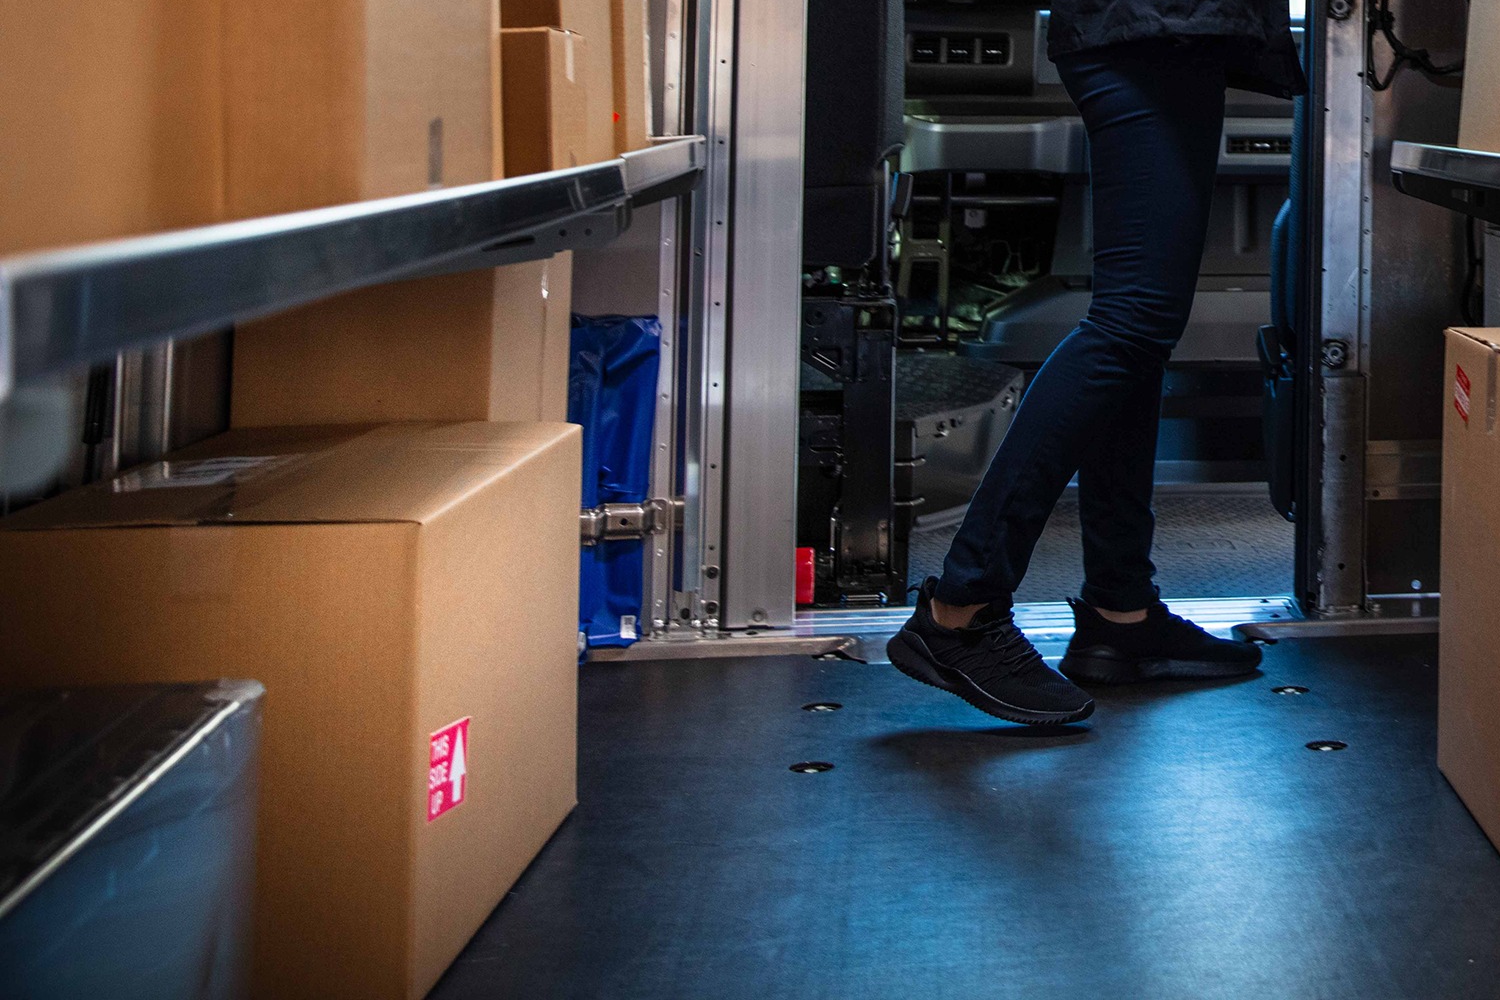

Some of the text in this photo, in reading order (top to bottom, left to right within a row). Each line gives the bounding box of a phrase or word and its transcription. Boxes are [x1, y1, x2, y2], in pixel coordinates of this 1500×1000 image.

[432, 735, 449, 761] THIS
[429, 761, 448, 789] SIDE
[431, 790, 443, 814] UP
